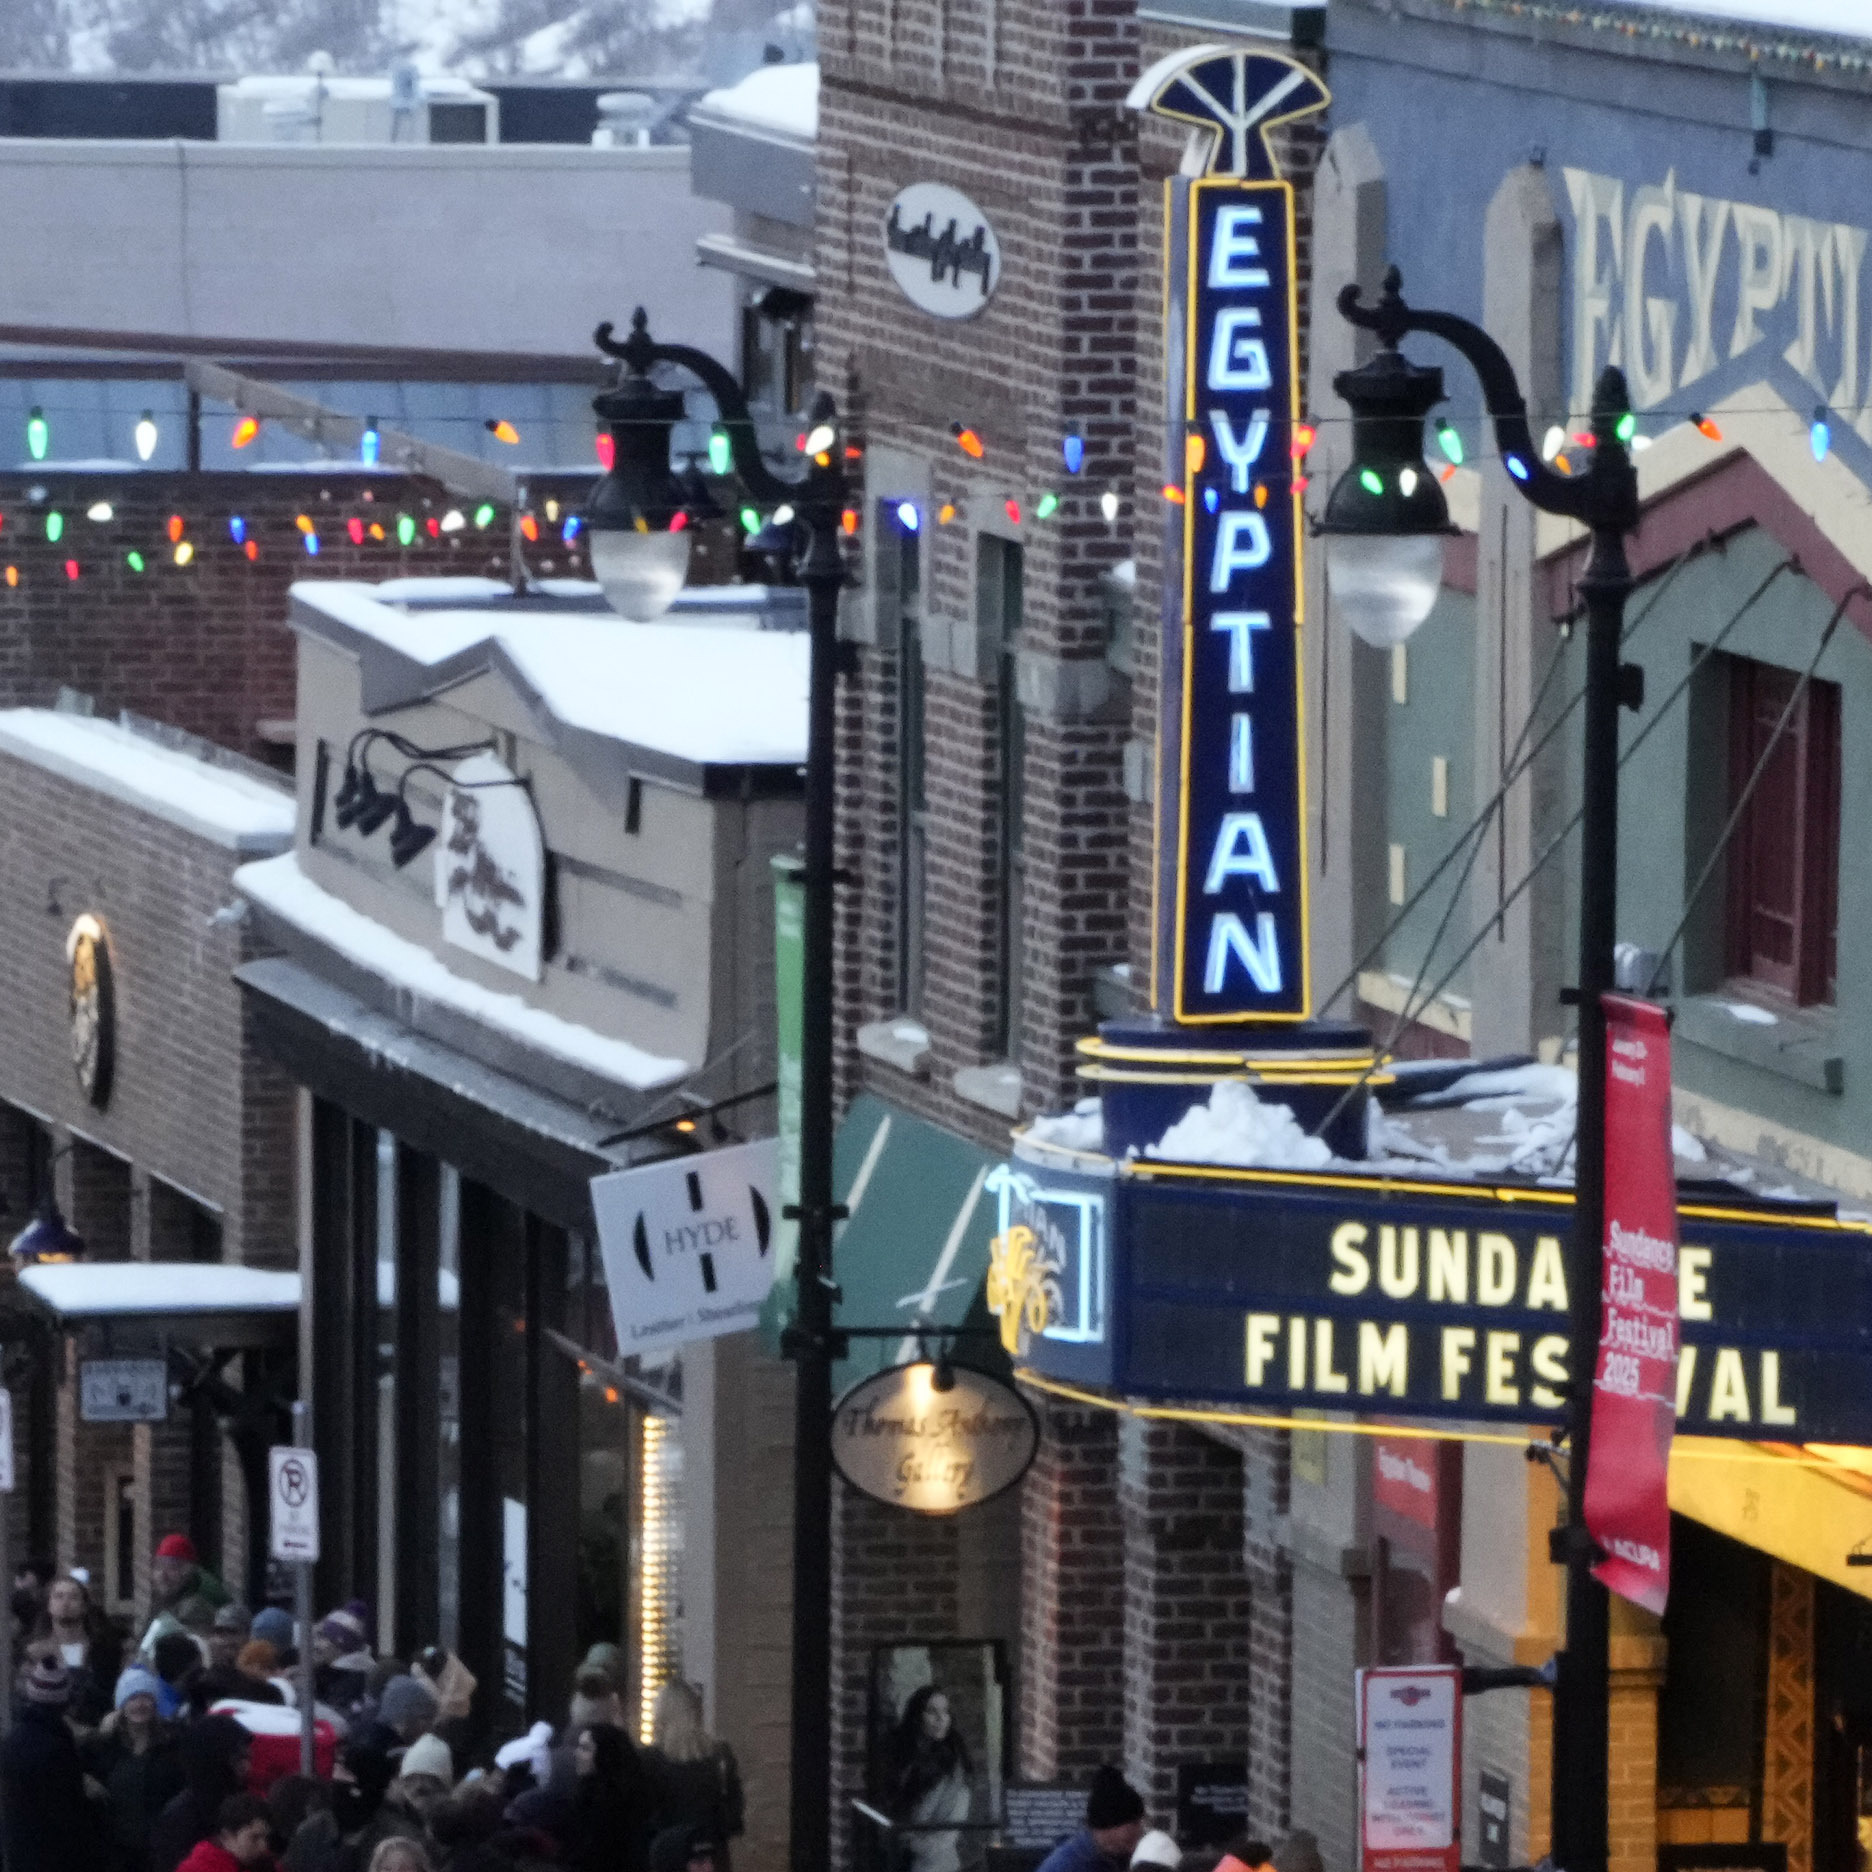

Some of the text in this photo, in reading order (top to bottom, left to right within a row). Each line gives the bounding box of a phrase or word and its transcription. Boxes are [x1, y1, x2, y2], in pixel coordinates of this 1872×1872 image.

[1202, 204, 1282, 994] EGYPTIAN
[664, 1215, 741, 1255] HYDE
[1330, 1222, 1713, 1321] SUNDAE
[1245, 1313, 1409, 1398] FILM
